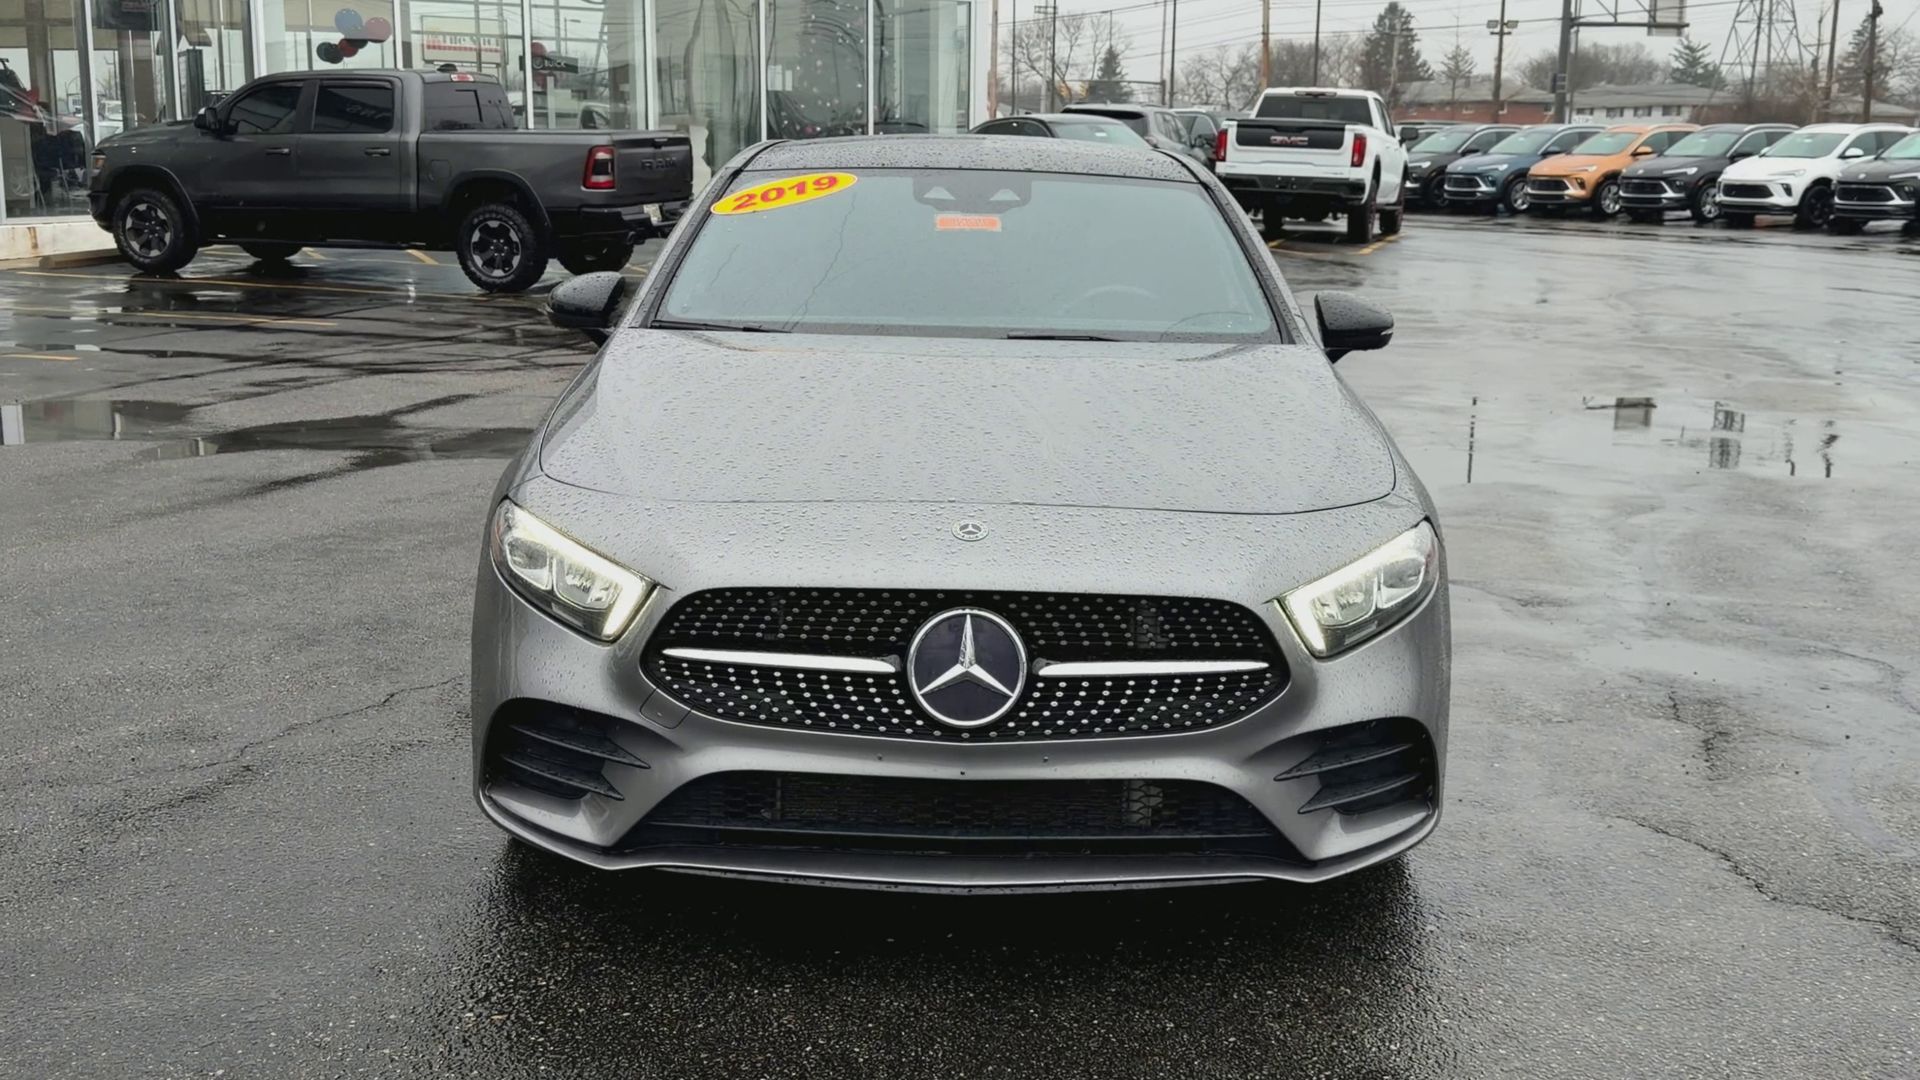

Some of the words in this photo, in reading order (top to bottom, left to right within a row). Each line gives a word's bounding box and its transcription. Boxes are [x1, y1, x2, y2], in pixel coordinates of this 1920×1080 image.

[1269, 135, 1309, 146] GMC
[640, 157, 678, 171] RAM
[732, 175, 840, 211] 2019
